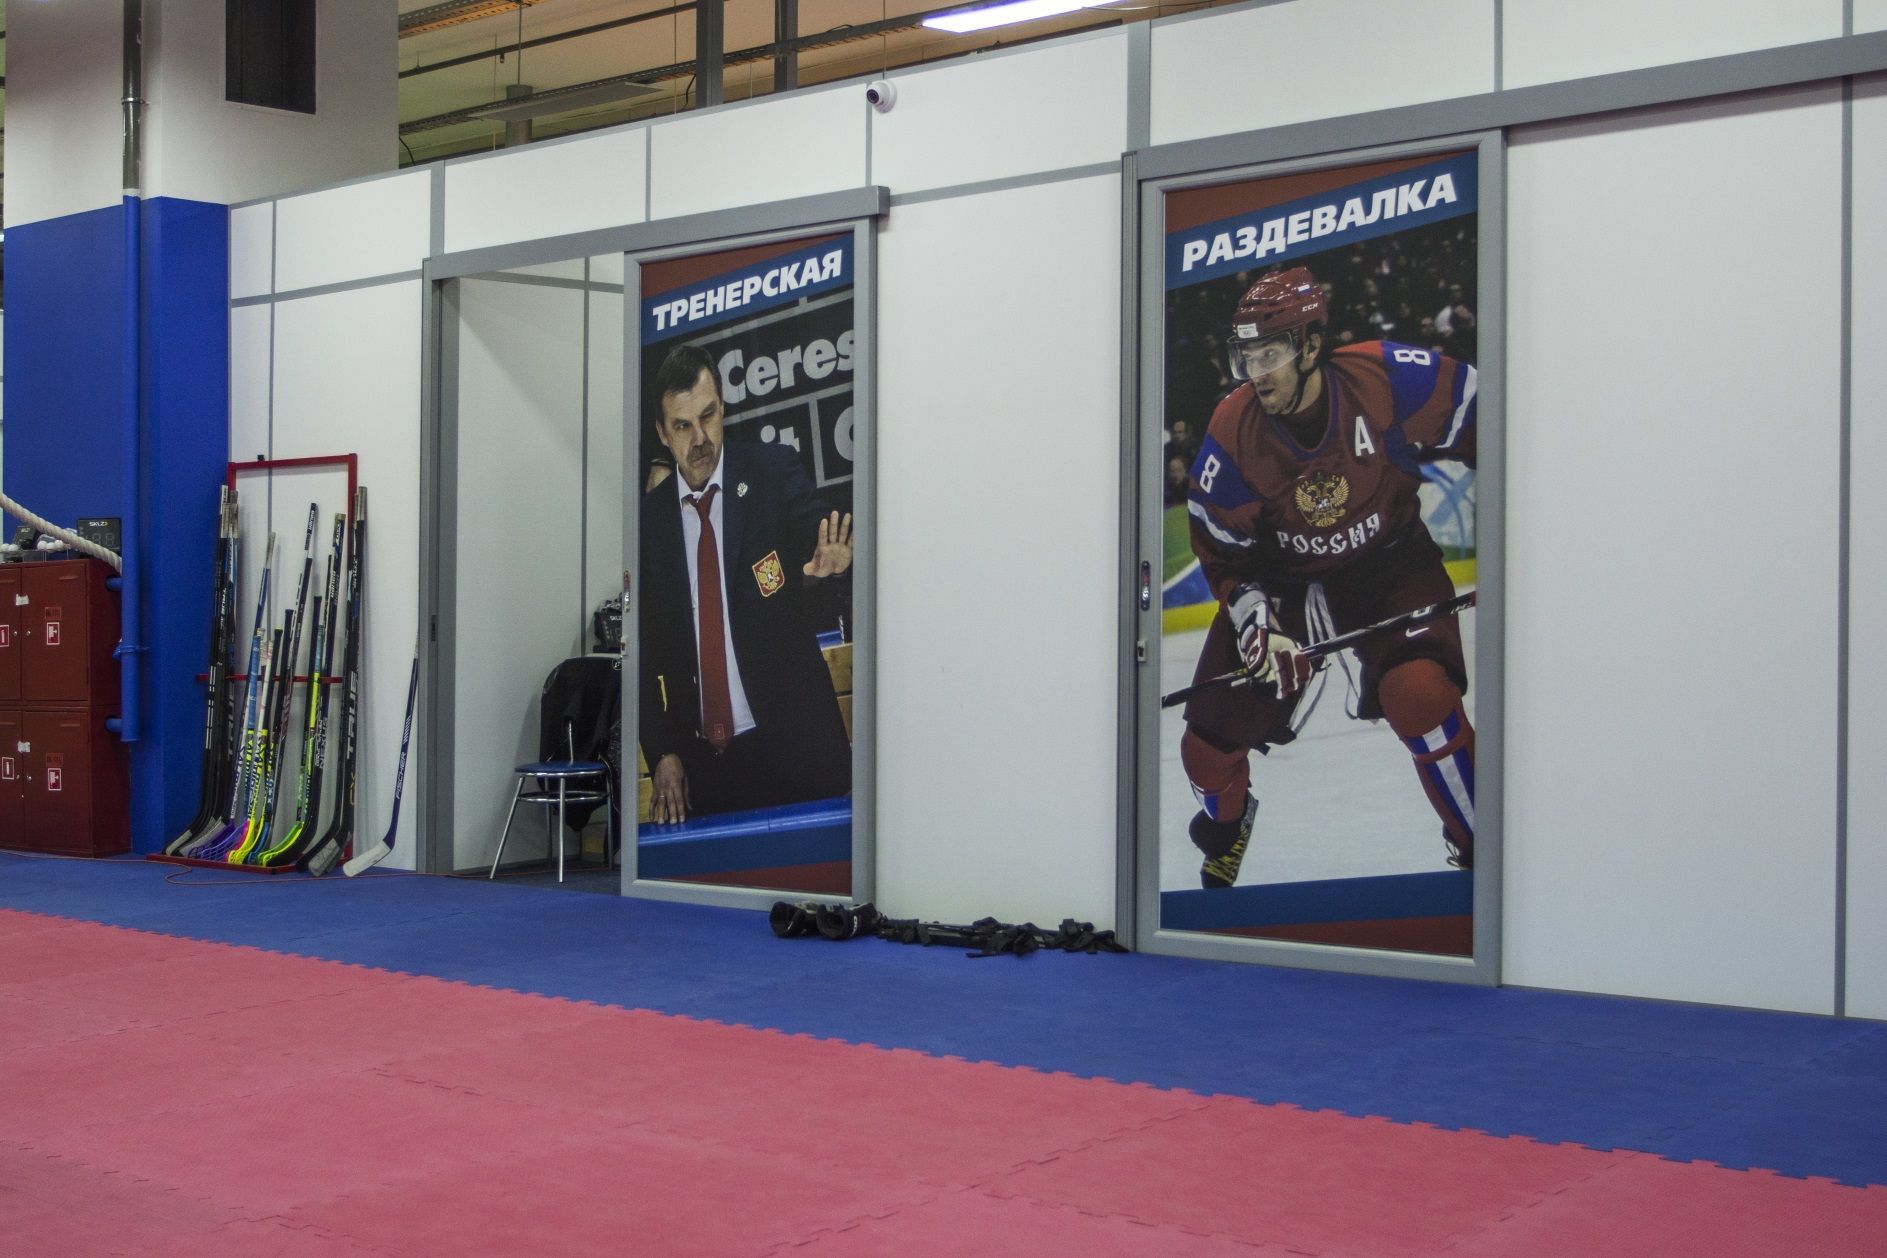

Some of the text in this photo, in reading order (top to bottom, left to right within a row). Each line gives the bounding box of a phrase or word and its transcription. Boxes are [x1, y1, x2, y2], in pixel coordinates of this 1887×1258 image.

[1182, 173, 1457, 272] РАЗДЕВАЛКА
[652, 249, 842, 331] ТРЕНЕРСКАЯ
[1302, 303, 1318, 312] CCM
[718, 329, 854, 404] Ceres
[1393, 348, 1431, 366] 8
[1354, 415, 1375, 457] A
[1199, 454, 1221, 494] 8
[1276, 512, 1380, 555] РОССИЯ
[347, 671, 358, 760] TRUE
[395, 751, 406, 800] FISCHER
